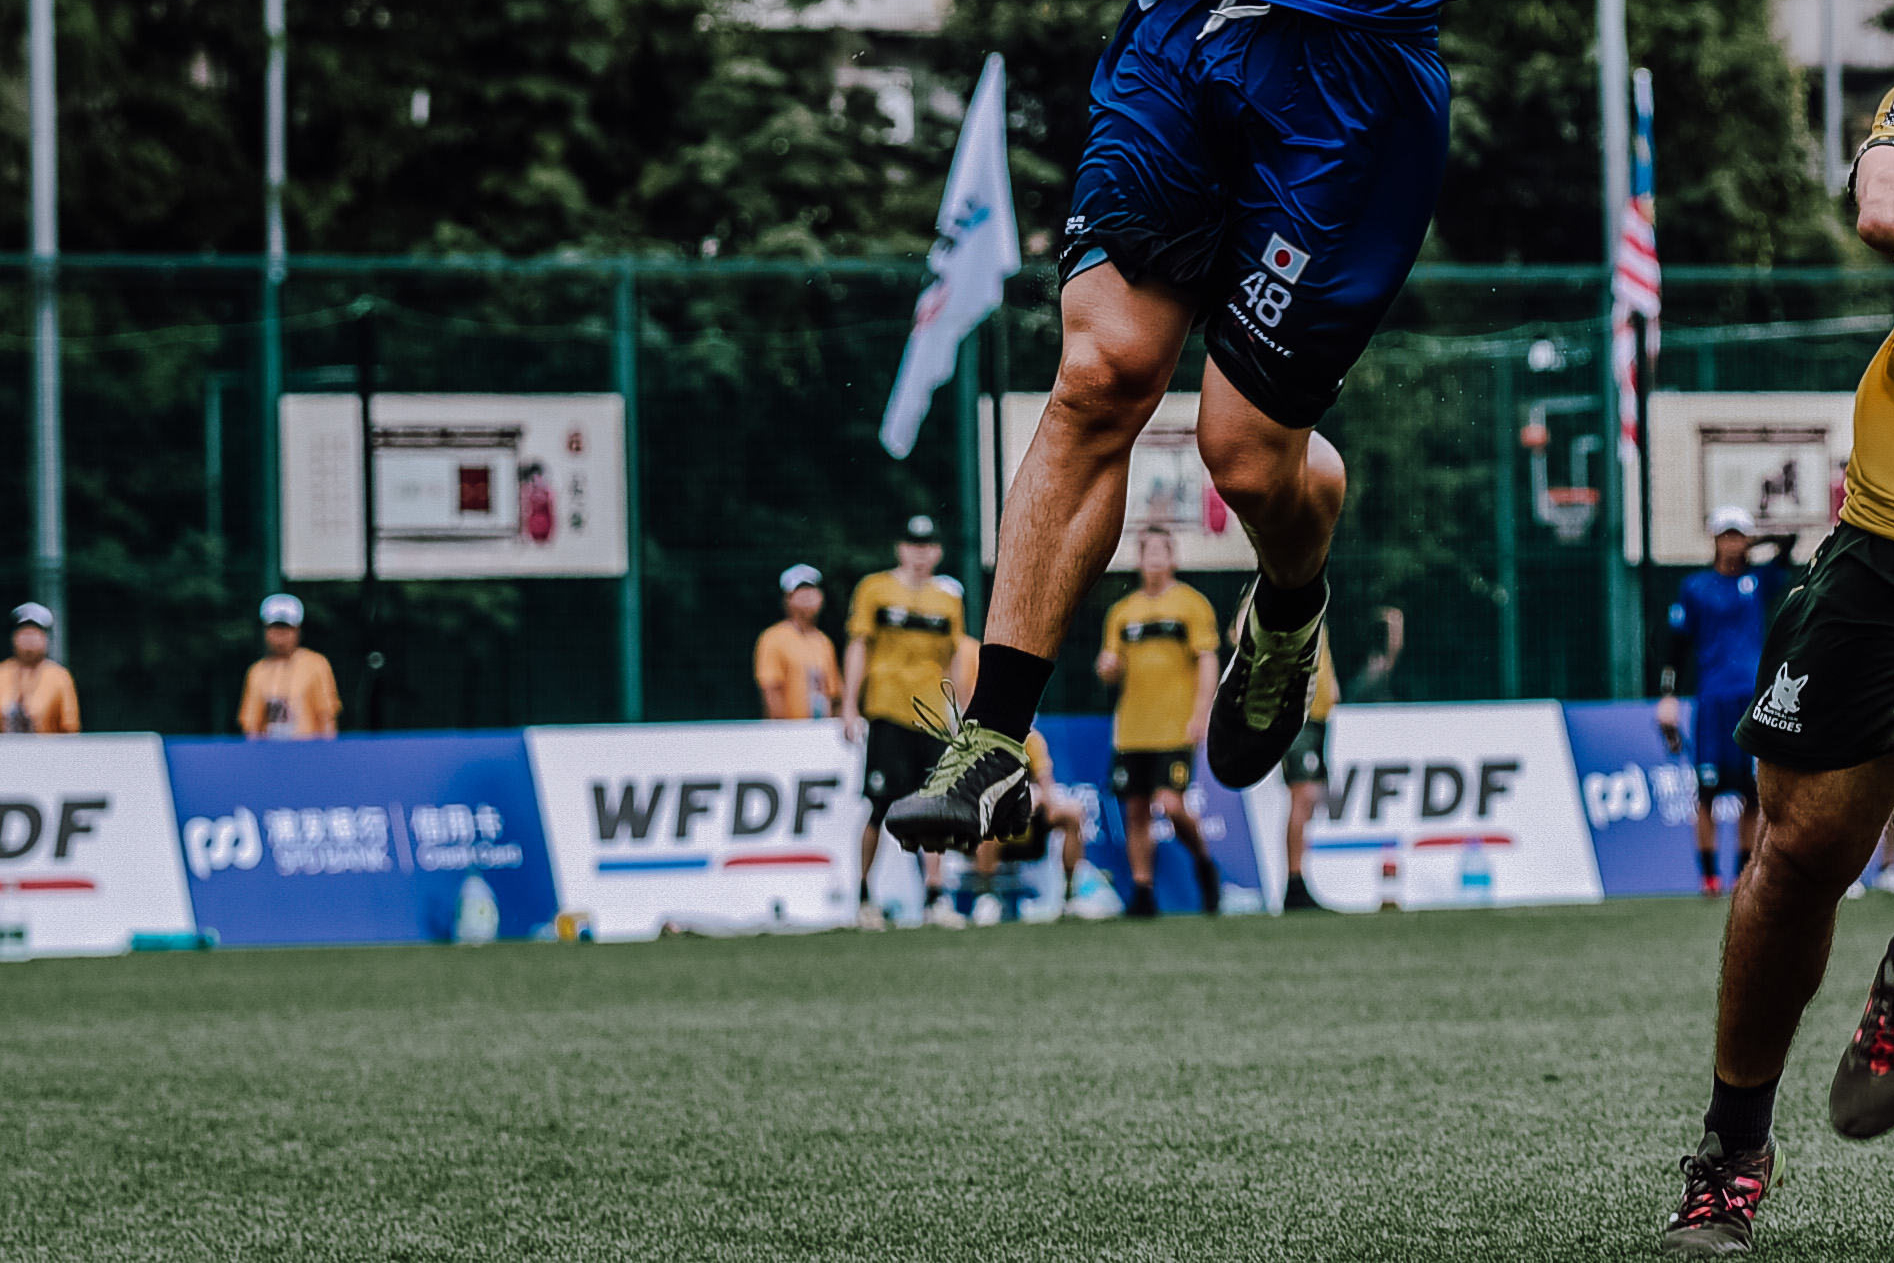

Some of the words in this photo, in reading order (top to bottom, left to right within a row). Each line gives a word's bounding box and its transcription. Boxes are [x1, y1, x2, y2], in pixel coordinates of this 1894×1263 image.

[1239, 270, 1292, 328] 48
[1752, 705, 1803, 733] DINGOES
[594, 779, 839, 839] WFDF
